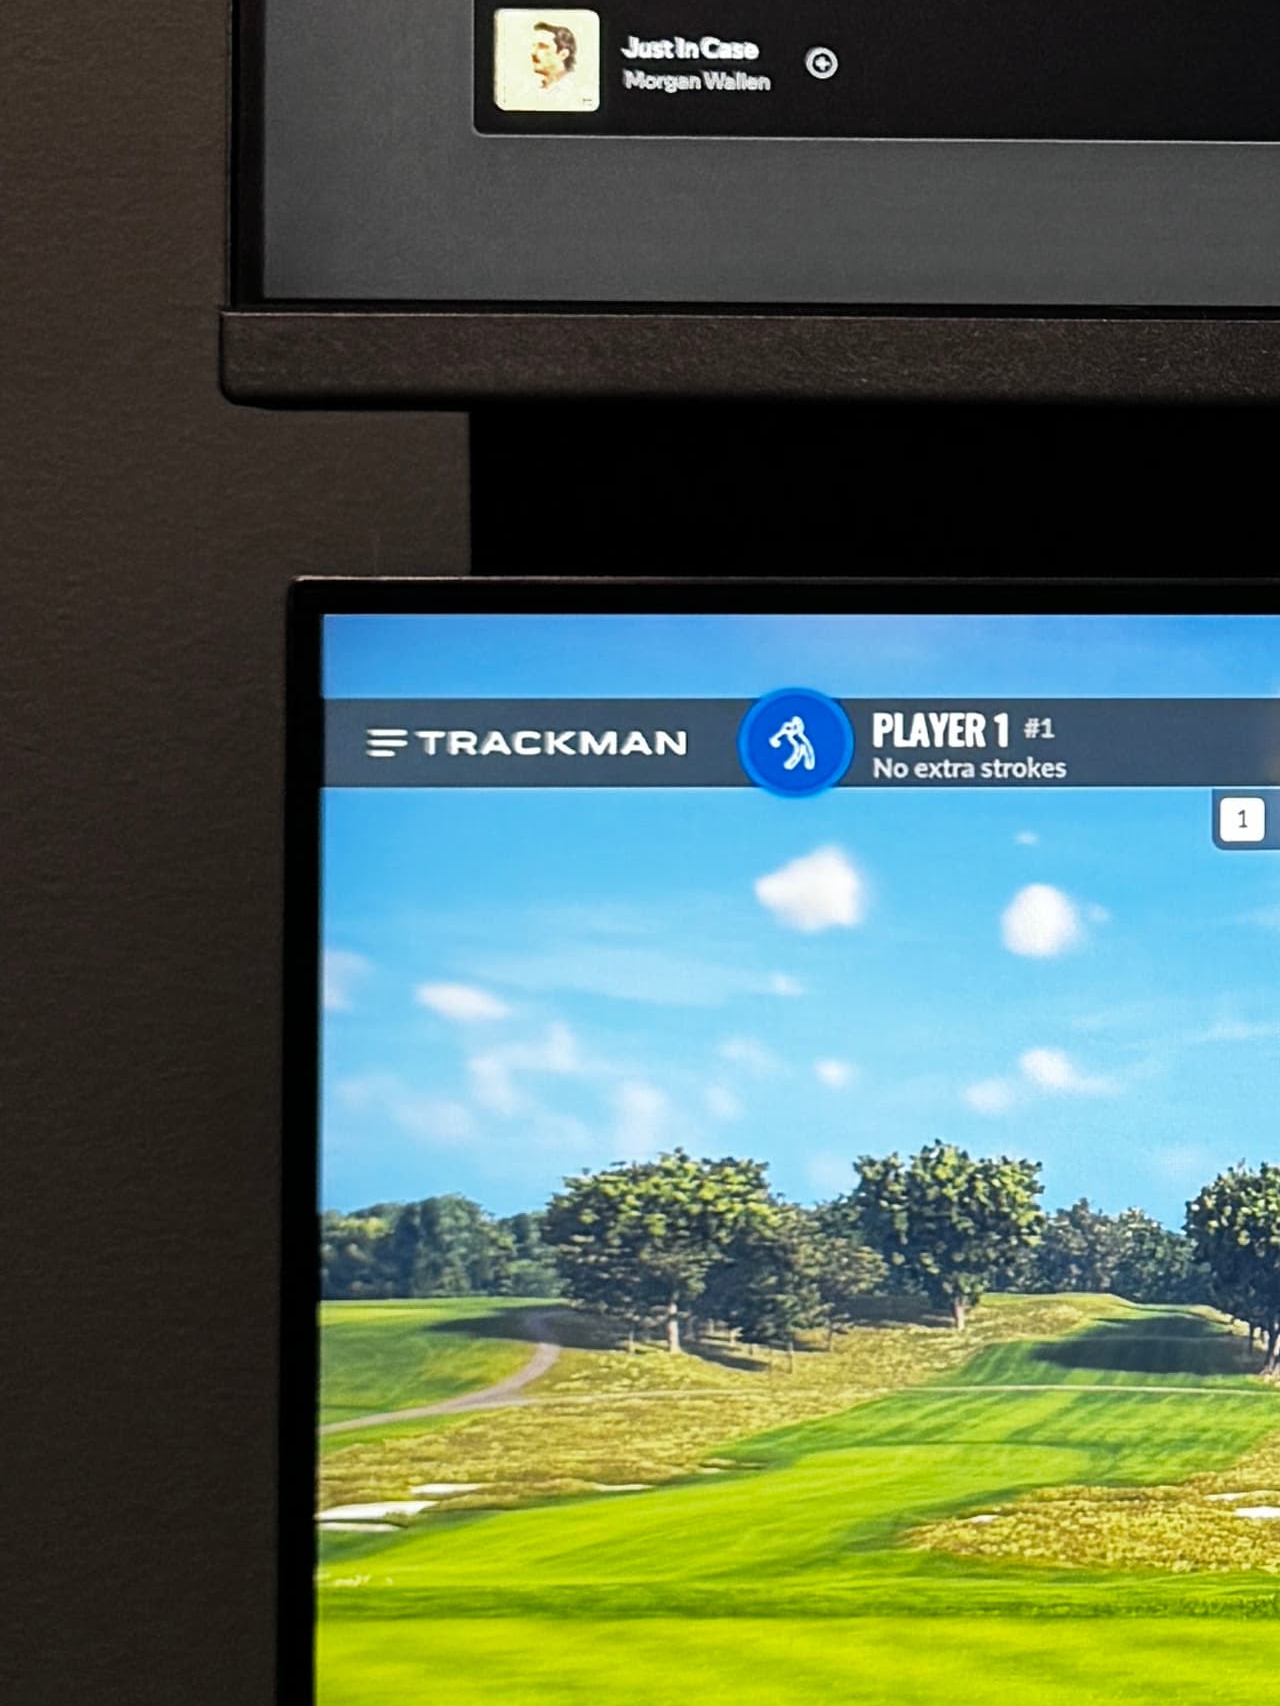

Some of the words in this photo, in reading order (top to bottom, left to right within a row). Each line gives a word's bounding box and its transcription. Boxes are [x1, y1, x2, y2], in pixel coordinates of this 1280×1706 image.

[414, 729, 688, 757] TRACKMAN
[873, 713, 986, 749] PLAYER
[994, 713, 1010, 748] 1
[1024, 719, 1056, 739] #1
[873, 758, 908, 779] No
[913, 758, 976, 779] extra
[981, 758, 1068, 780] strokes
[1237, 809, 1249, 829] 1
